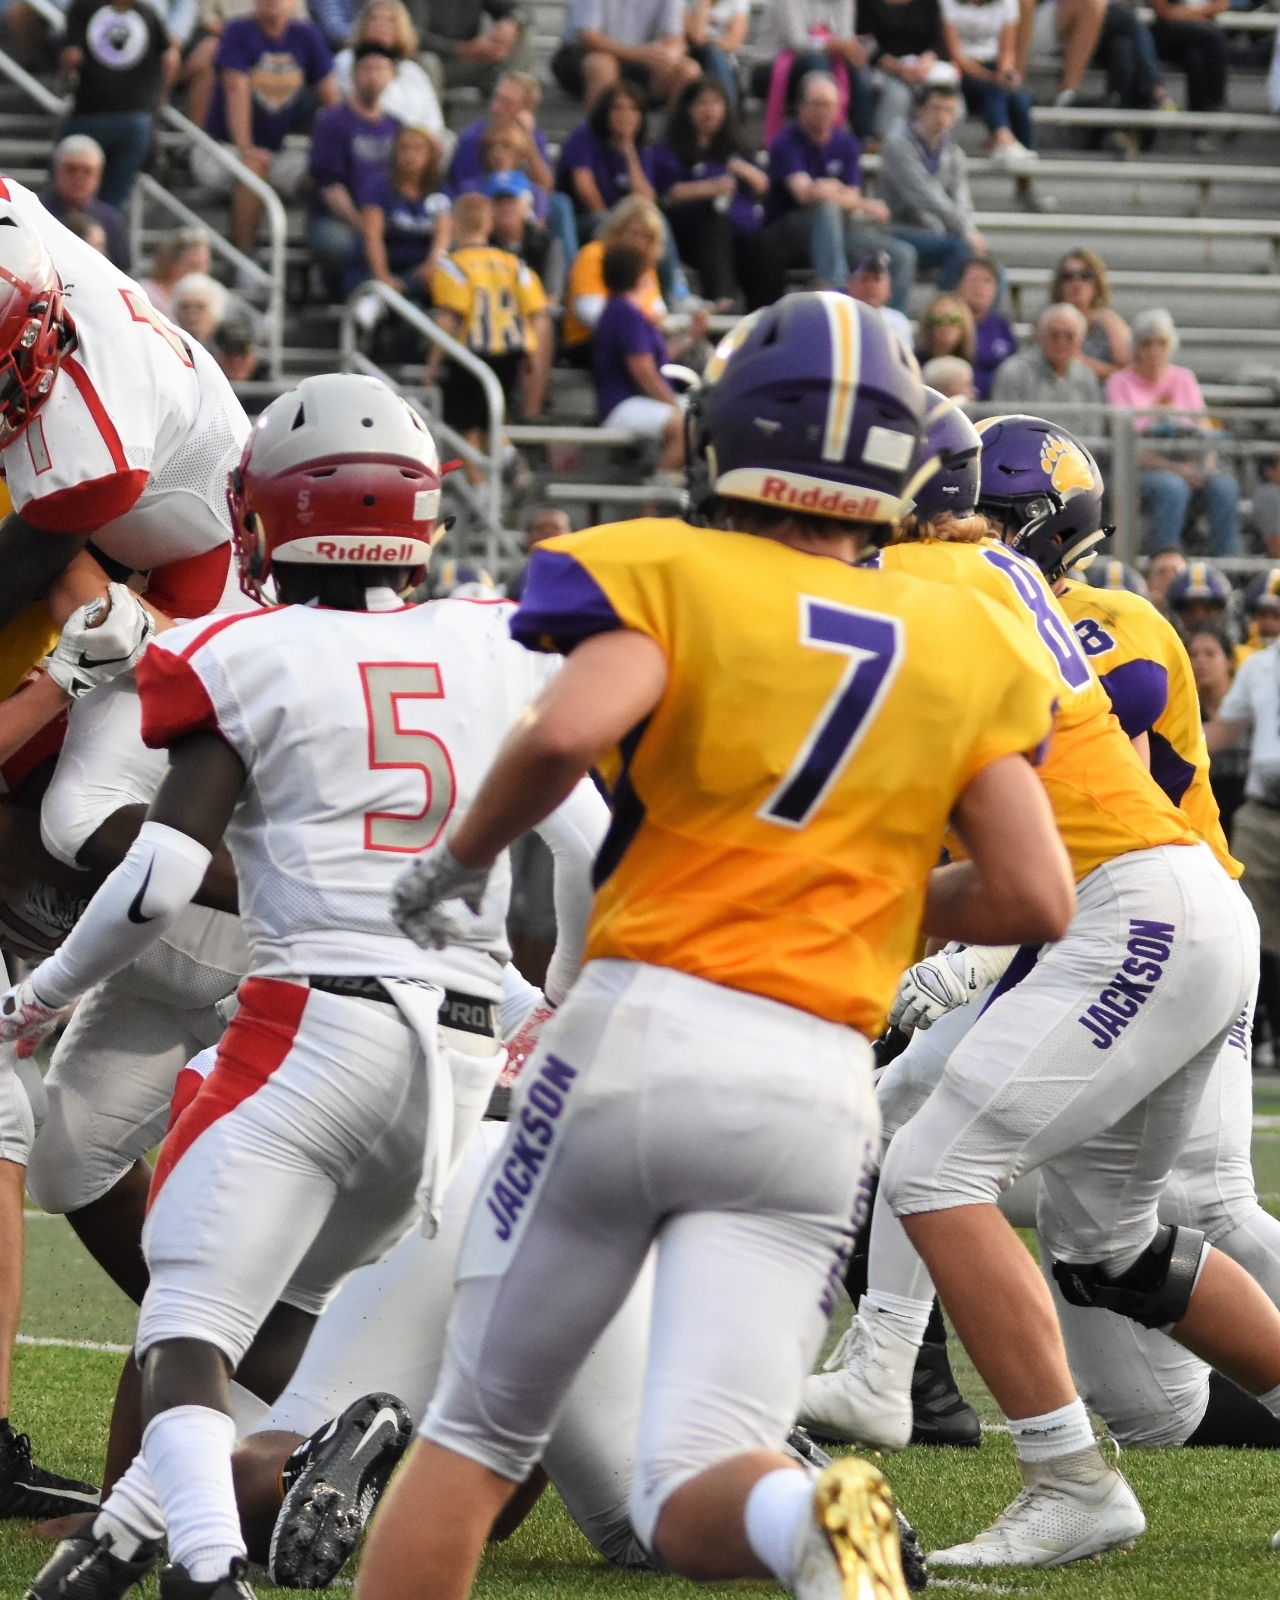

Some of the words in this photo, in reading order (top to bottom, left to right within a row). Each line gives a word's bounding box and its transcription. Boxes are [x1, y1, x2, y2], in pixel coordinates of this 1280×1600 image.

[316, 542, 414, 562] Riddell
[760, 475, 881, 519] Riddell
[357, 661, 457, 854] 5
[755, 592, 905, 833] 7
[1078, 919, 1175, 1050] JACKSON
[487, 1053, 578, 1242] JACKSON
